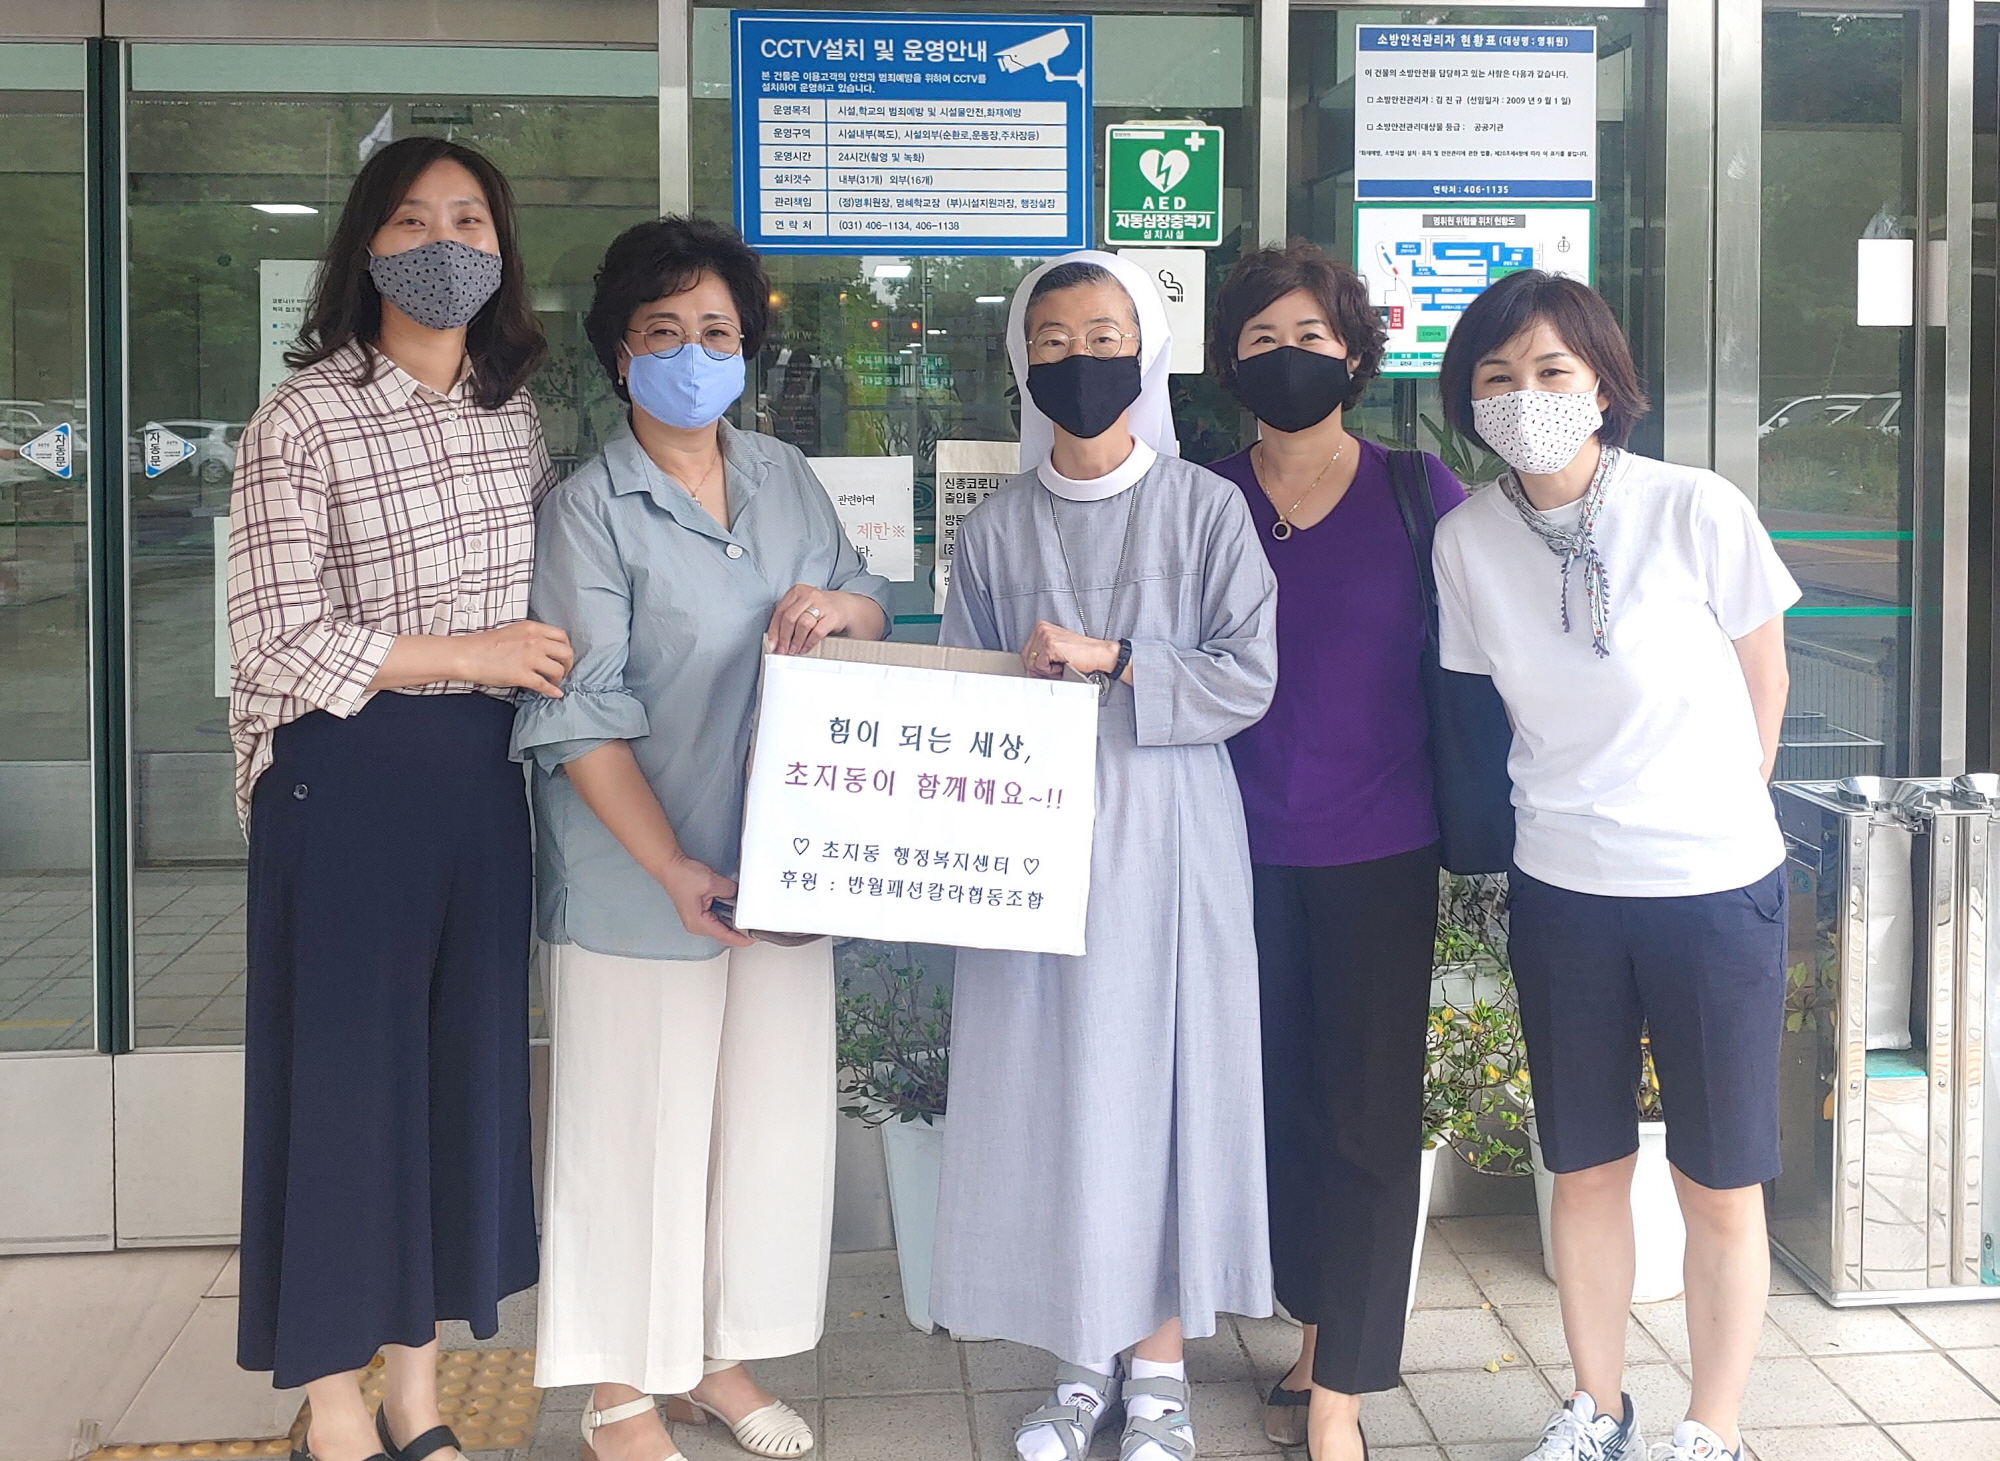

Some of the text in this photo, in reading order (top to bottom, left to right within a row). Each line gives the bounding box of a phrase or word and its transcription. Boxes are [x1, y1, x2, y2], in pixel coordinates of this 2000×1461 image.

[1377, 33, 1455, 47] 소방안전관리자
[761, 38, 988, 63] CCTV설치 및 운영안내
[761, 71, 987, 84] 본 건물은 이용고객의 안전과 범죄예방을 위하여 CCTV를
[1365, 69, 1569, 78] 이 건물의 소방안전을 담당하고 있는 사람은 다음과 같습니다.
[761, 82, 876, 94] 설치하여 운영하고 있습니다.
[1376, 96, 1428, 104] 소방안전관리자
[773, 105, 811, 116] 운영목적
[838, 106, 1022, 118] 시설,학교의 범죄예방 및 시설물안전,화재예방
[773, 128, 811, 139] 운영구역
[1376, 123, 1444, 132] 소방안전관리대상물
[1474, 123, 1504, 132] 공공기관
[838, 129, 1040, 141] 시설내부(복도), 시설외부(순환로,운동장,주차장등)
[773, 151, 812, 162] 운영시간
[838, 152, 925, 163] 24시간(촬영 및 녹화)
[774, 174, 812, 184] 설치갯수
[839, 175, 934, 186] 내부(31개) 외부(16개)
[1463, 185, 1509, 194] 406-1135
[774, 197, 812, 208] 관리책임
[838, 197, 1056, 209] (정)명휘원장, 명혜학교장 (부)시설지원과장, 행정실장
[1142, 196, 1187, 210] AED
[838, 220, 960, 232] (031) 406-1134, 406-1138
[1115, 214, 1211, 230] 자동심장충격기
[1478, 215, 1493, 226] 위치
[55, 434, 67, 468] 자동문
[150, 432, 162, 467] 자동문
[944, 478, 1000, 490] 신종코로나
[837, 494, 875, 506] 관련하여
[945, 492, 977, 504] 출입을
[829, 716, 1031, 764] 힘이 되는 세상,
[784, 761, 1063, 810] 초지동이 함께해요~!!
[822, 840, 1010, 875] 초지동 행정복지센터
[780, 870, 818, 892] 후원
[848, 876, 1044, 910] 반월패션칼라협동조합
